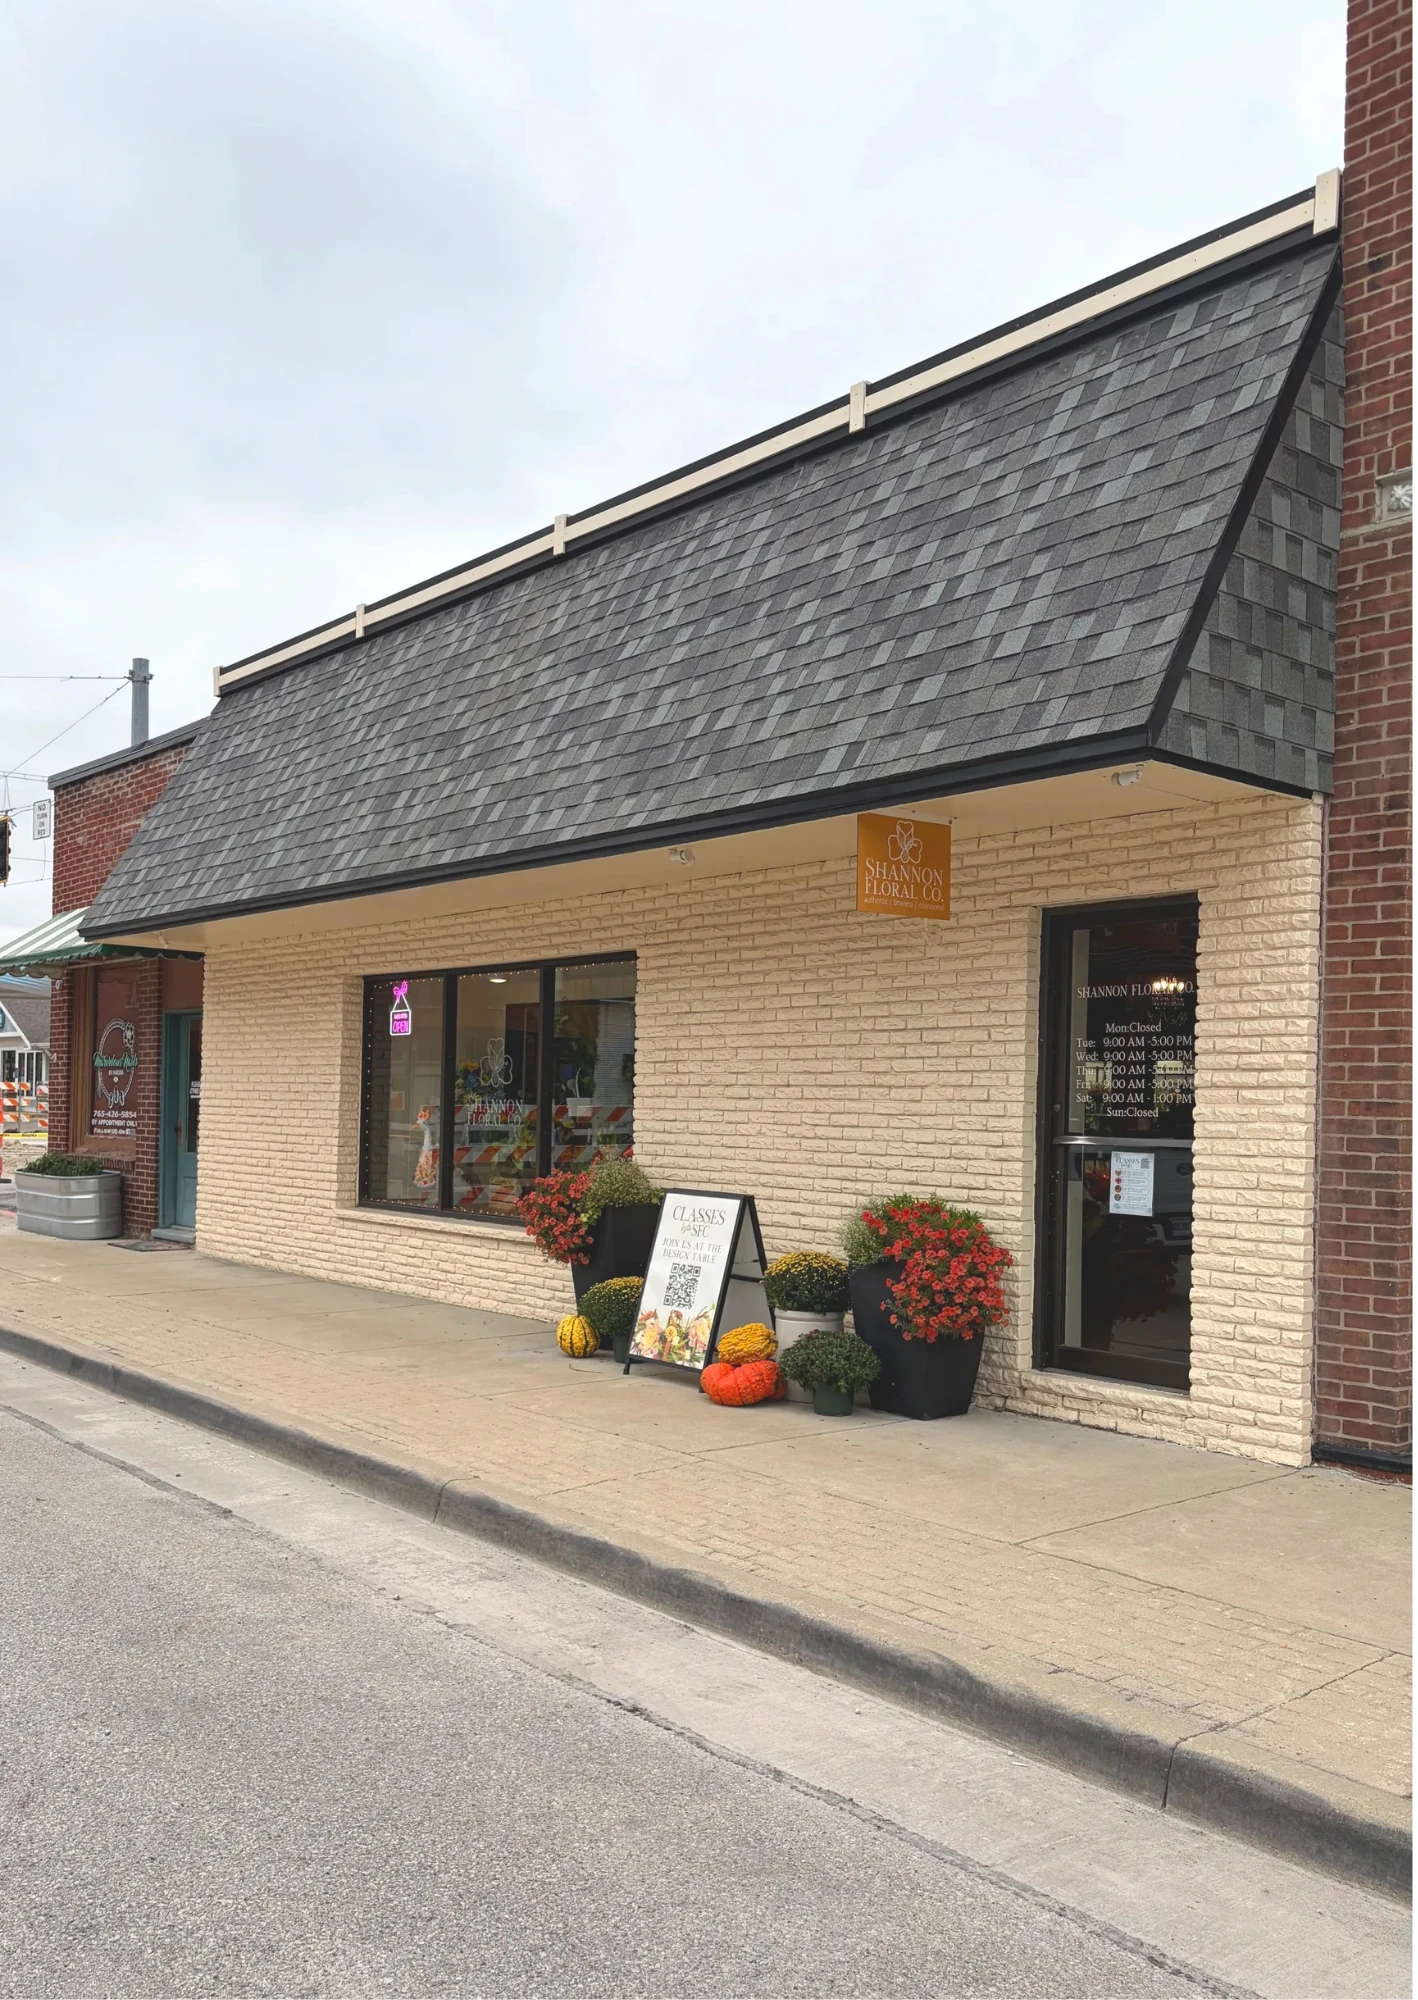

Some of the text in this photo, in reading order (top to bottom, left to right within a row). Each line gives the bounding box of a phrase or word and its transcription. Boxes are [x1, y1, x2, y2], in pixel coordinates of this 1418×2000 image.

[37, 803, 46, 811] NO
[865, 857, 944, 886] SHANNON
[864, 876, 944, 902] FLORAL CO.
[1076, 984, 1128, 999] SHANNON
[393, 1020, 409, 1033] OPEN
[1076, 1037, 1096, 1048] Tue:
[1103, 1037, 1126, 1047] 9:00
[1127, 1036, 1145, 1047] AM
[1176, 1035, 1193, 1046] PM
[1076, 1051, 1099, 1061] Wed:
[1103, 1051, 1126, 1061] 9:00
[1127, 1051, 1146, 1061] AM
[1177, 1050, 1193, 1060] PM
[1103, 1065, 1126, 1075] 9:00
[1127, 1065, 1146, 1075] AM
[1103, 1079, 1126, 1089] 9:00
[1127, 1079, 1146, 1089] AM
[1177, 1079, 1193, 1089] PM
[467, 1095, 523, 1114] SHANNON
[1076, 1093, 1092, 1103] Sat:
[1102, 1093, 1125, 1103] 9:00
[1126, 1093, 1144, 1103] AM
[1153, 1093, 1174, 1103] 1:00
[1176, 1093, 1192, 1104] PM
[93, 1110, 137, 1118] 765-426-5854
[467, 1112, 504, 1127] FLORAL
[98, 1119, 126, 1127] APPOINTMENT
[672, 1205, 726, 1226] CLASSES
[691, 1223, 711, 1238] SFC
[662, 1237, 723, 1253] JOIN US AT THE
[662, 1248, 717, 1264] DESIGN TABLE
